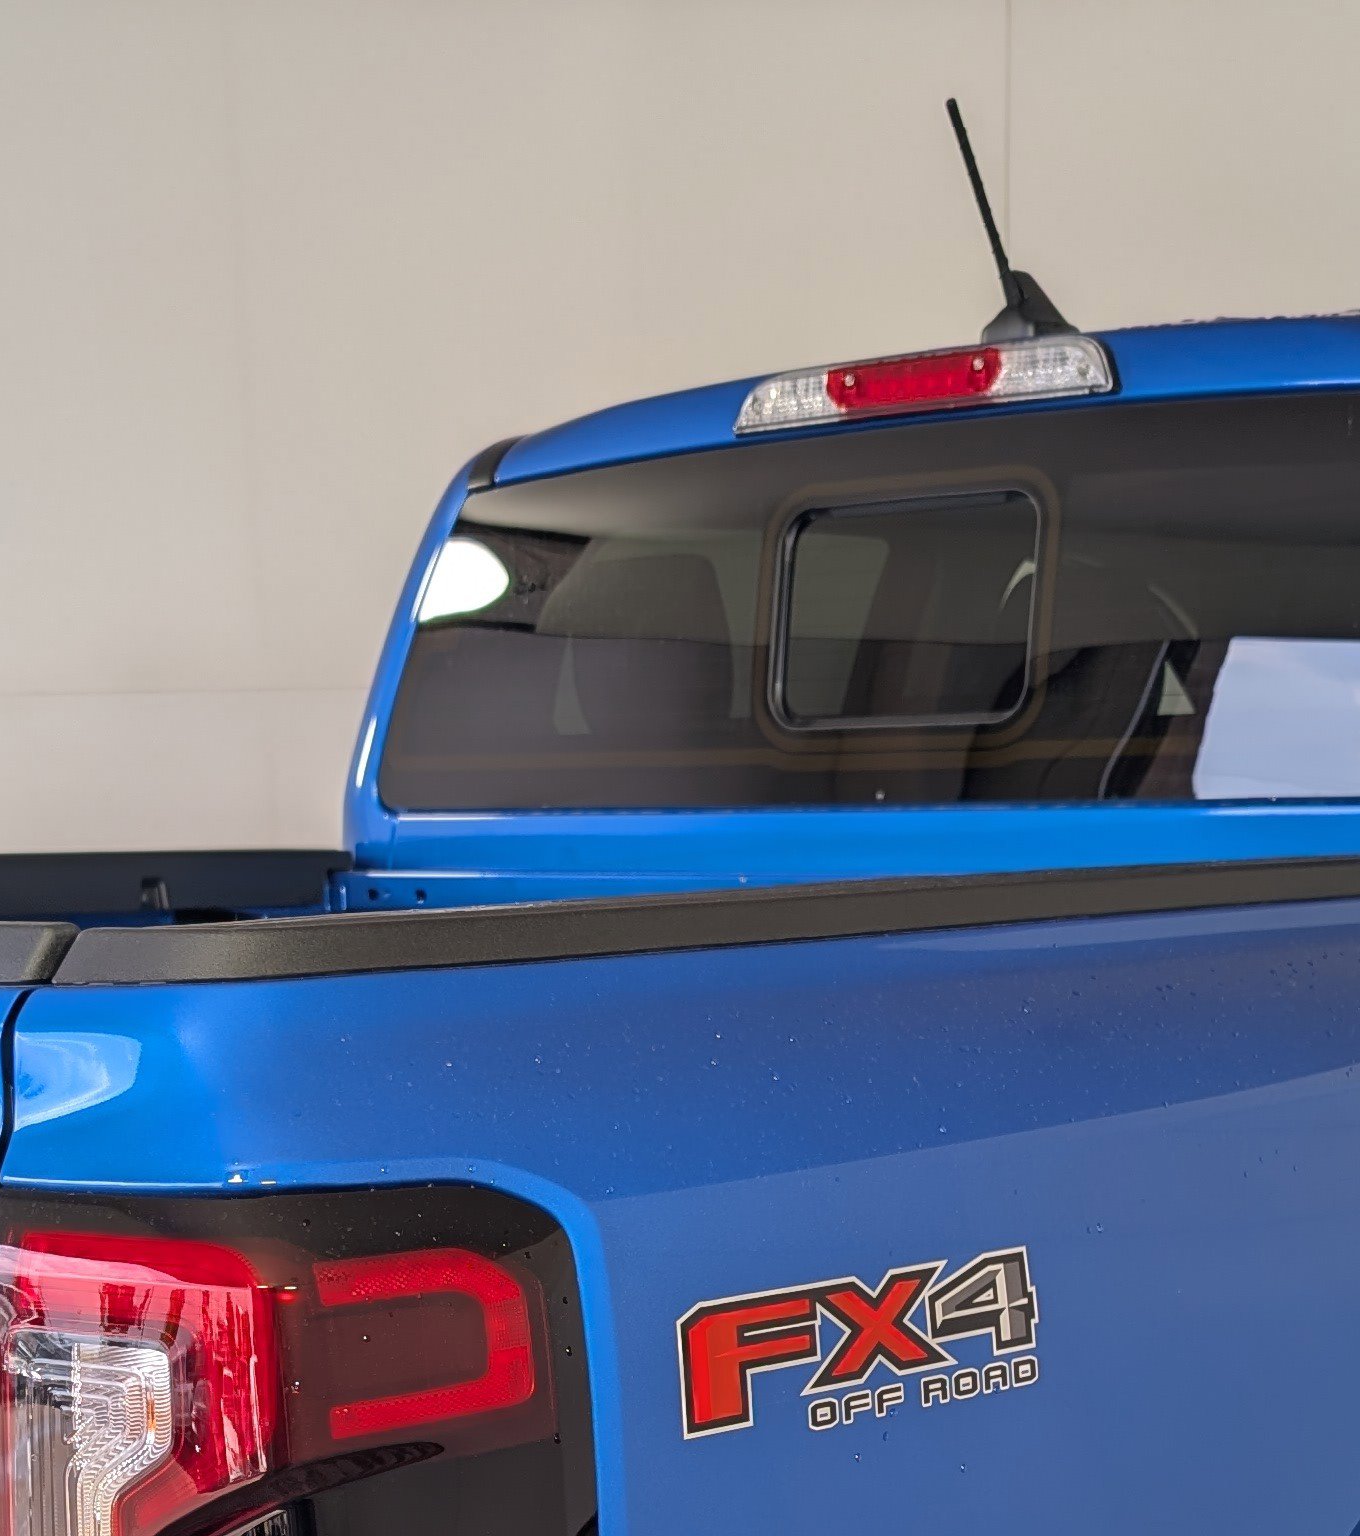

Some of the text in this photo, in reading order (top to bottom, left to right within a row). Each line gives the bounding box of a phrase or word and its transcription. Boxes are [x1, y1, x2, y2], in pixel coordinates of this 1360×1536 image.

[676, 1246, 1039, 1440] FX4
[808, 1356, 1038, 1431] OFF ROAD
